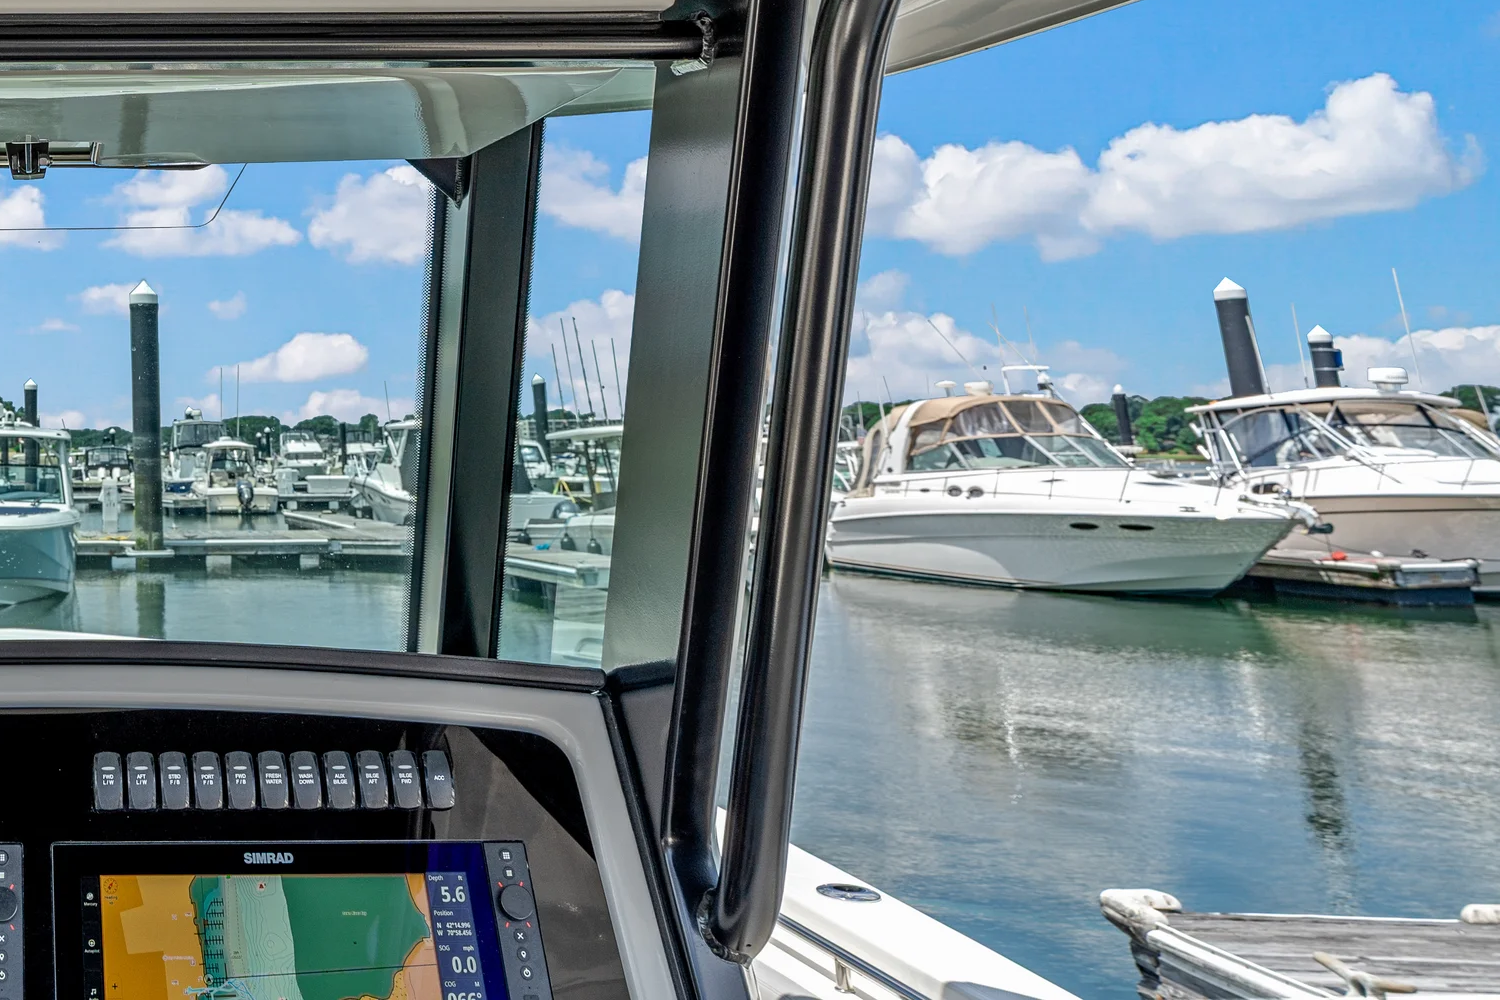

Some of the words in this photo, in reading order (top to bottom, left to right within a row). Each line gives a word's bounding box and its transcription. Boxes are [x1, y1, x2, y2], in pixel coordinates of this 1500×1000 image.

[244, 852, 294, 864] SIMRAD
[441, 886, 466, 903] 5.6
[452, 956, 477, 973] 0.0
